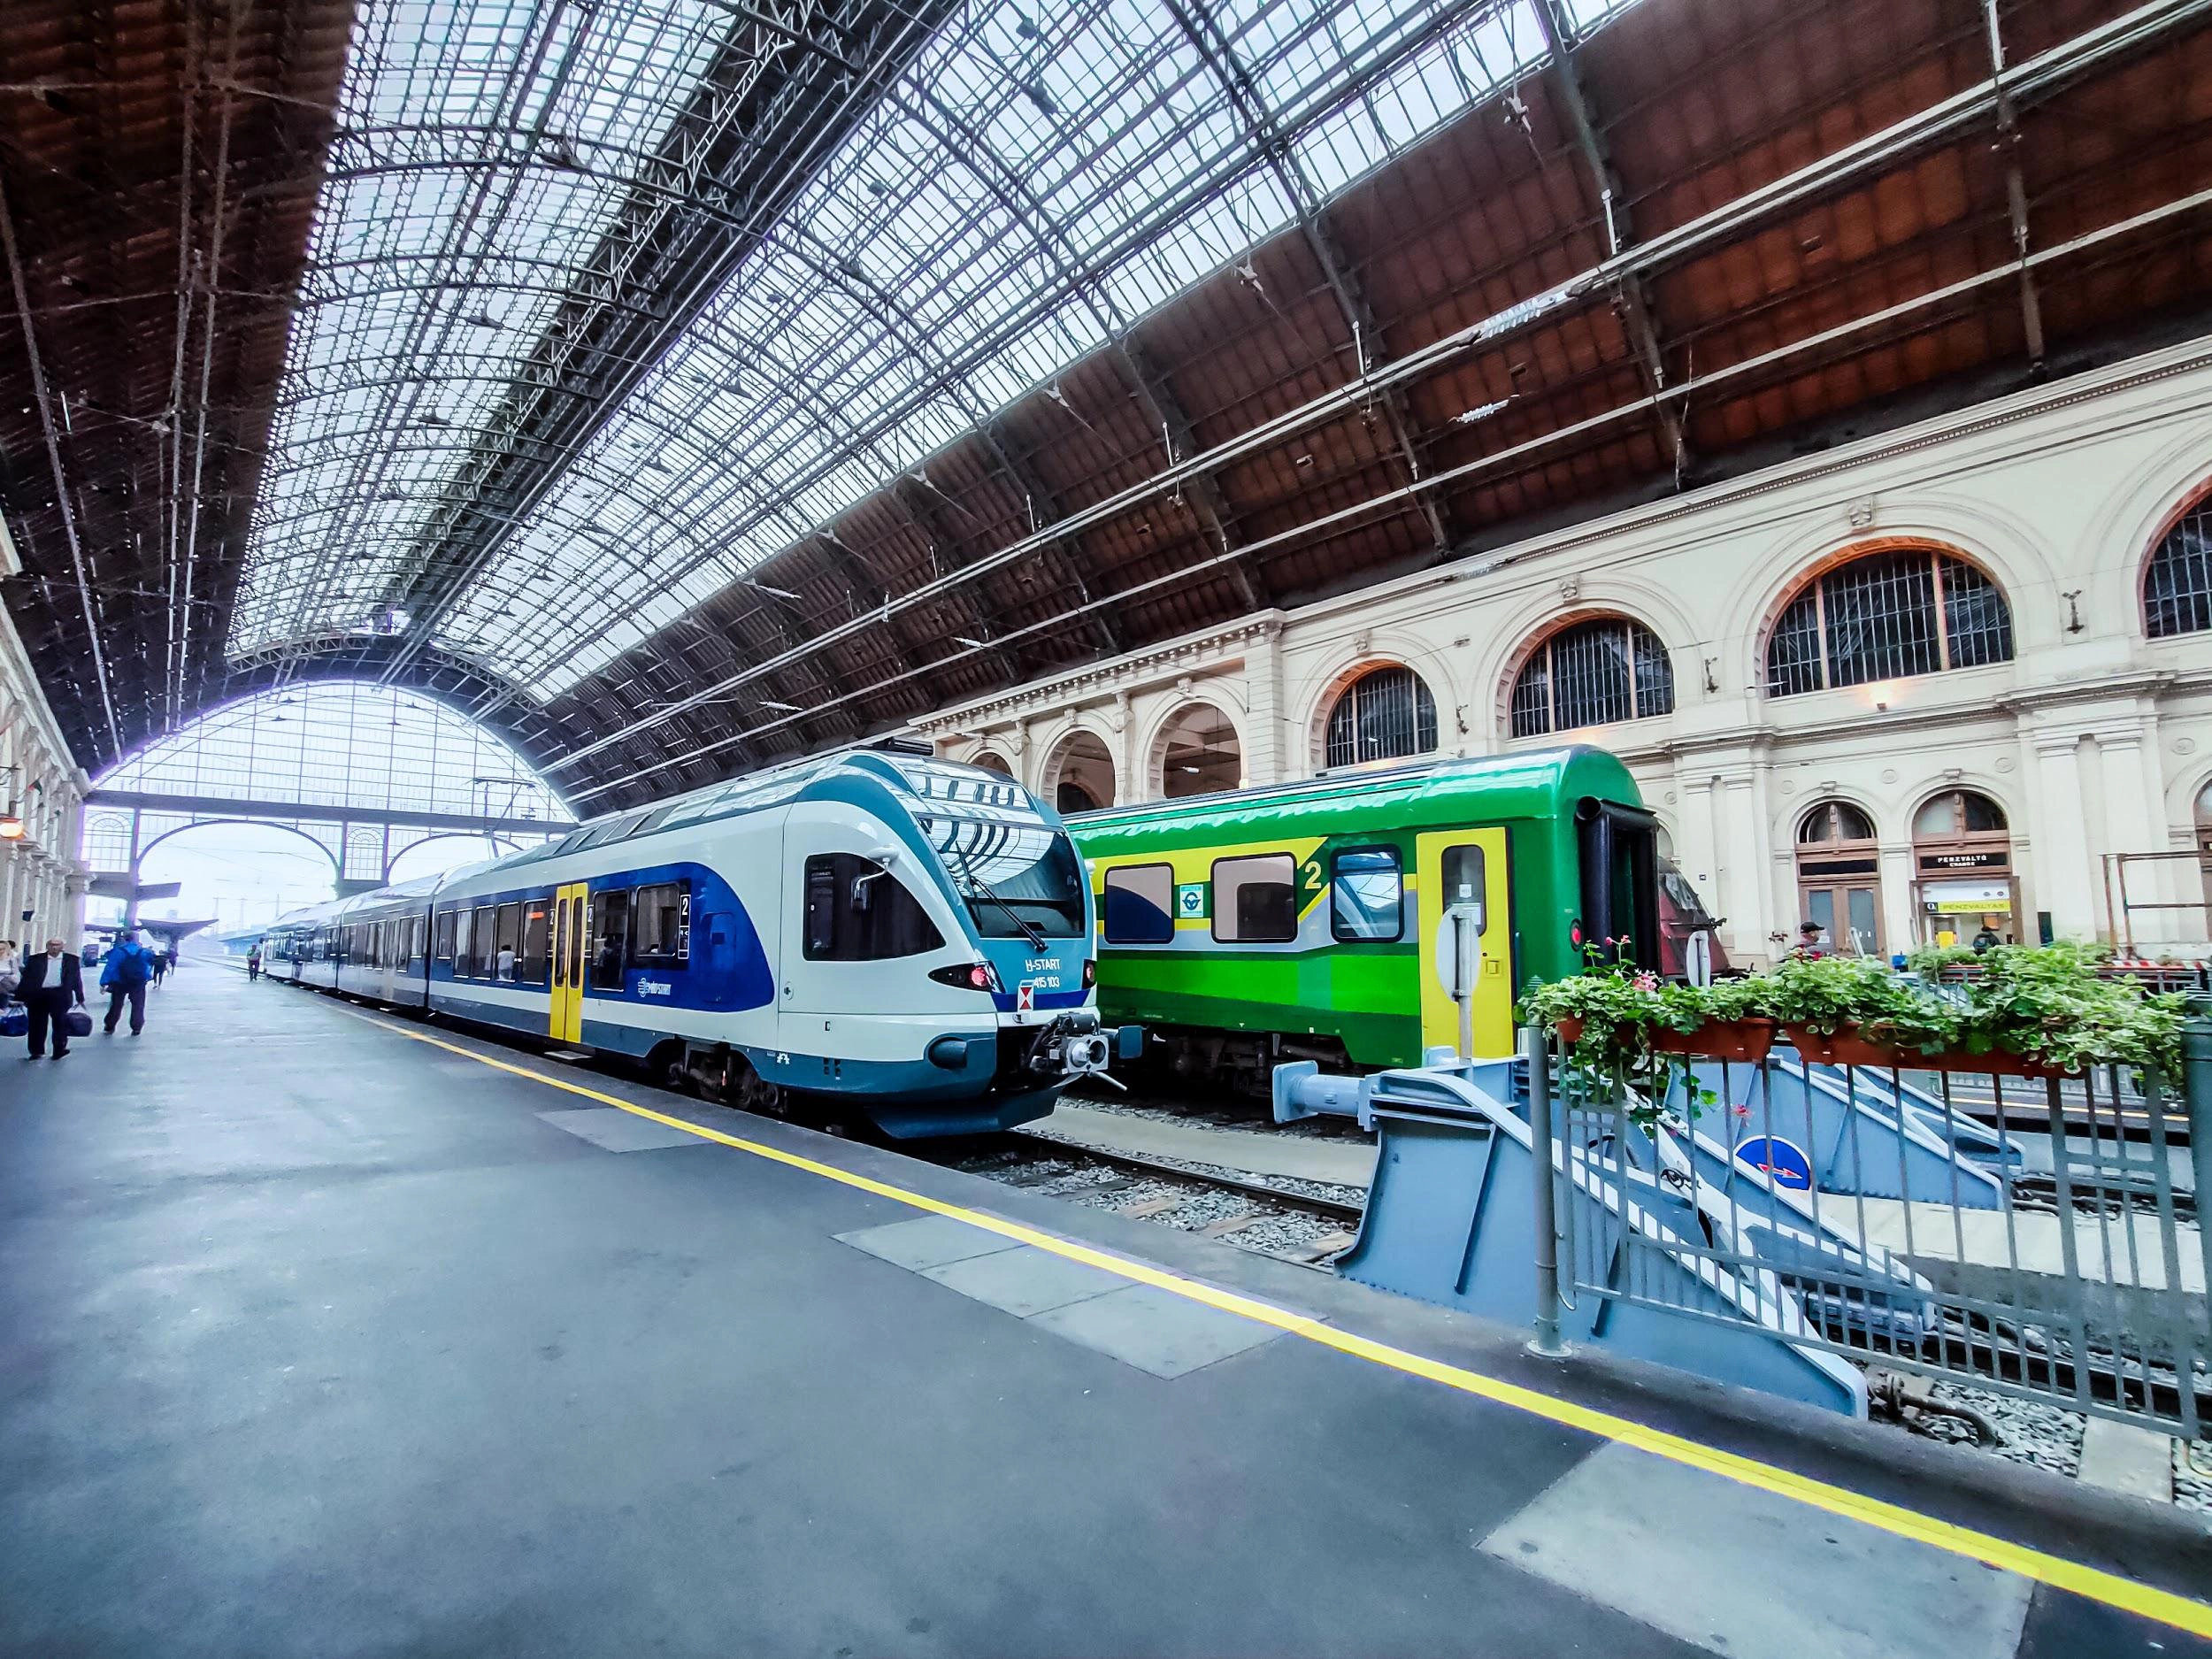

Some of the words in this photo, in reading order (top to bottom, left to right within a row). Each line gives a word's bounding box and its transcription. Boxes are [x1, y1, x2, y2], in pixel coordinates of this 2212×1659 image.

[1304, 861, 1322, 889] 2
[682, 897, 688, 916] 2
[549, 911, 554, 925] 2
[588, 908, 593, 922] 2
[1025, 958, 1061, 972] H-START
[1033, 976, 1047, 988] 415
[1047, 976, 1060, 988] 103
